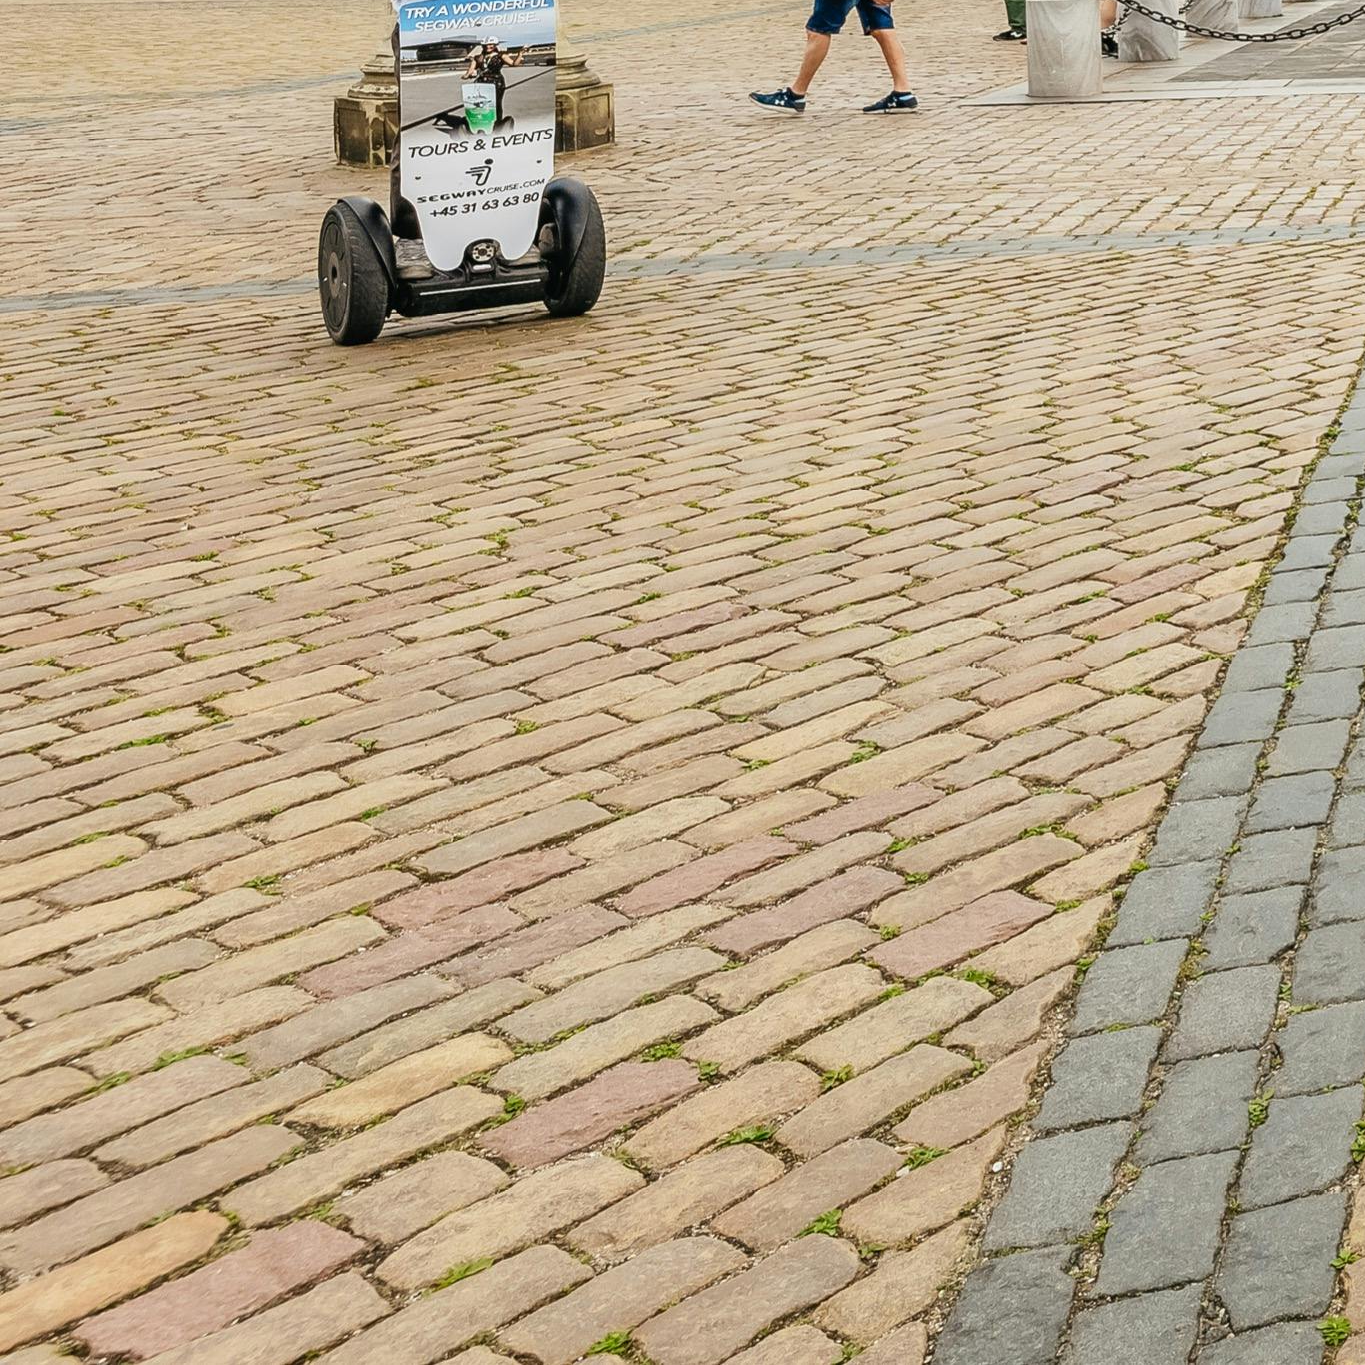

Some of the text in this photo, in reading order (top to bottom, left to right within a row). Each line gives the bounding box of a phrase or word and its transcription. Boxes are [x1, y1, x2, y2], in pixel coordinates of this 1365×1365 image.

[405, 6, 435, 19] TRY
[436, 7, 448, 17] A
[415, 17, 480, 32] SEGWAY
[408, 129, 554, 158] TOURS & EVENTS
[416, 178, 545, 204] SEGWAYCRUISE.COM
[430, 192, 539, 217] +45 31 63 63 80
